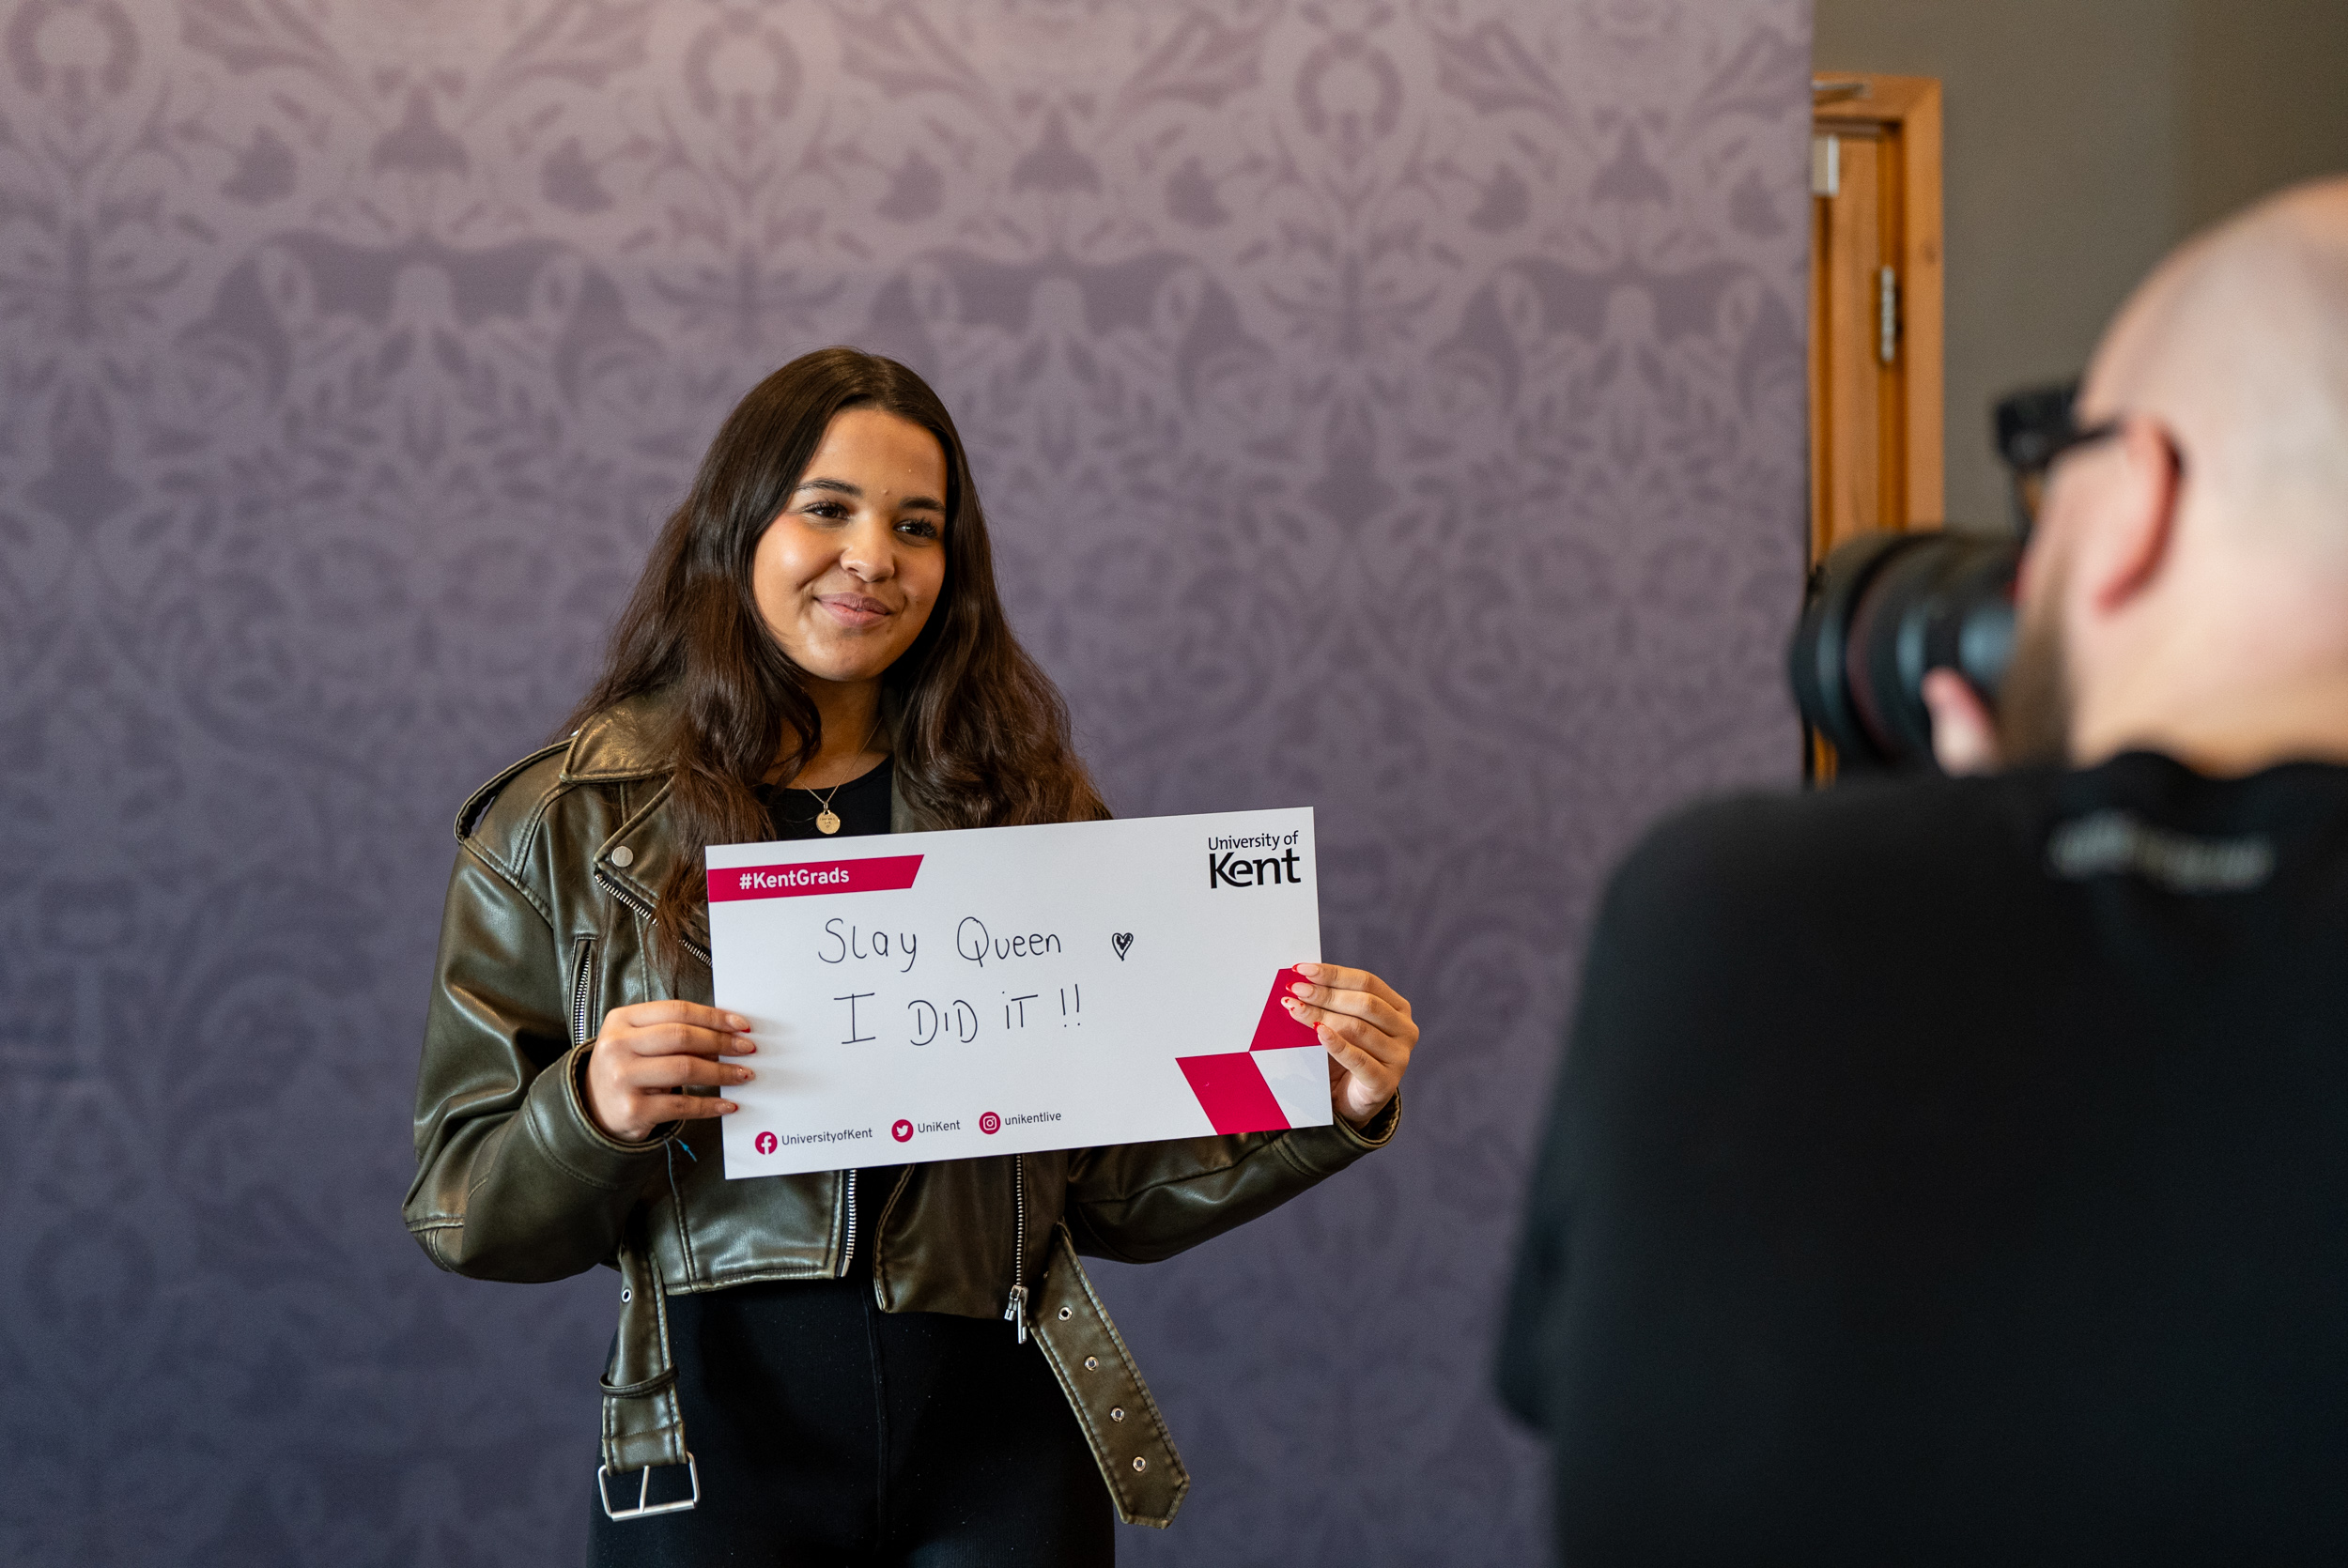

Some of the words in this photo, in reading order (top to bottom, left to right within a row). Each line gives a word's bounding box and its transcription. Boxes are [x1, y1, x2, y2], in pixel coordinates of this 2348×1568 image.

[1208, 833, 1280, 851] University
[1283, 830, 1299, 845] of
[739, 867, 850, 890] #KentGrads
[1209, 848, 1302, 889] Kent
[818, 917, 917, 973] Slay
[956, 916, 1061, 968] Queen
[833, 992, 876, 1045] I
[781, 1128, 873, 1146] UniversityofKent
[917, 1119, 961, 1133] UniKent
[1004, 1112, 1062, 1126] unikentlive
